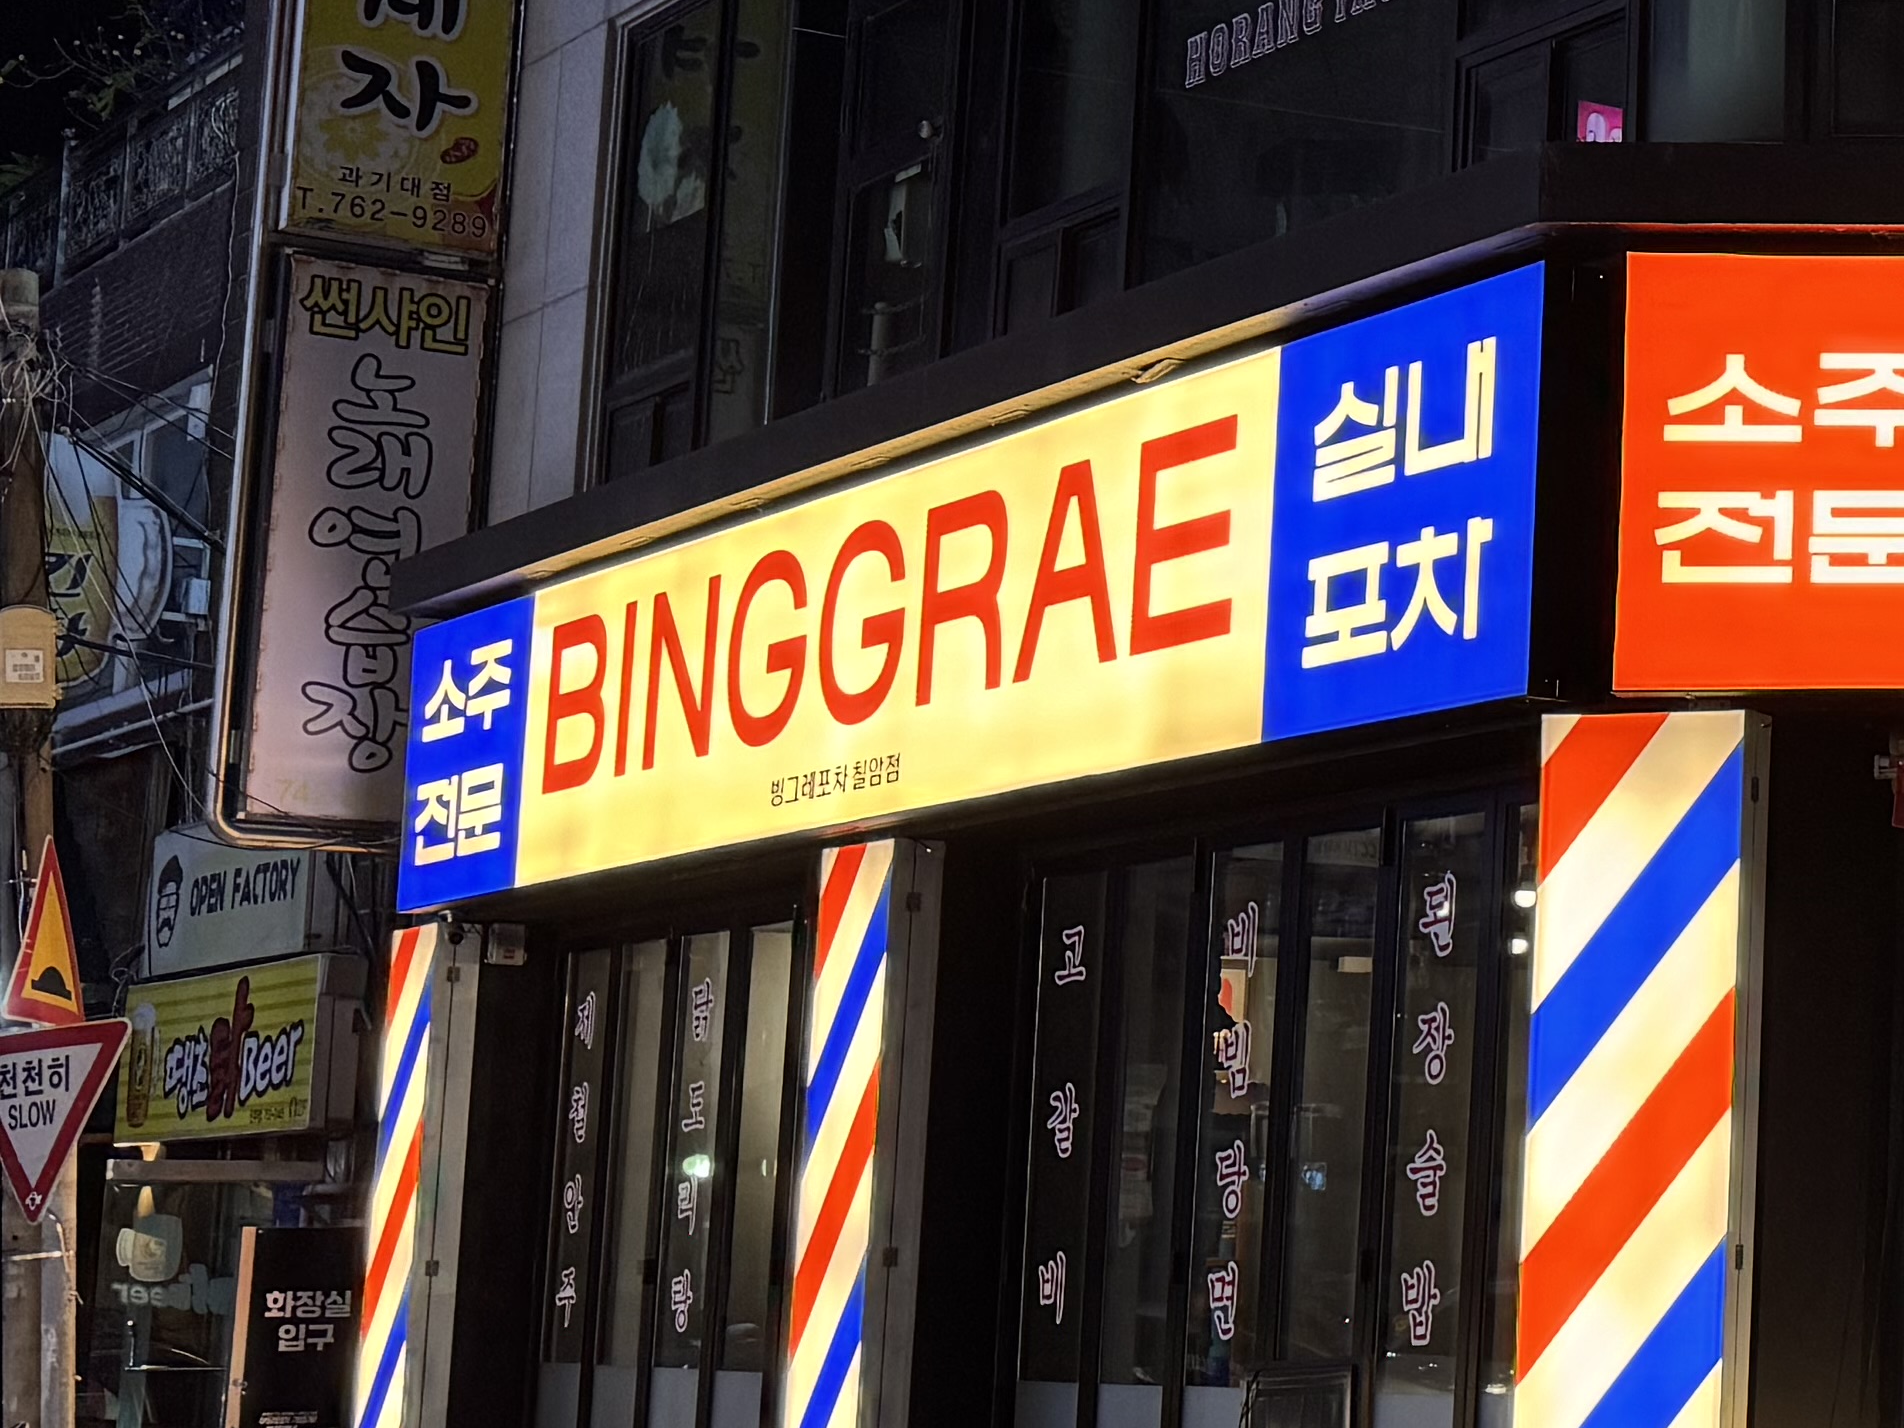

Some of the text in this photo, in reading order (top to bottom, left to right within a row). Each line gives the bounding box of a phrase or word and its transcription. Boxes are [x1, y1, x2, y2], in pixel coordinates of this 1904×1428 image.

[295, 183, 489, 241] T.762-9289
[299, 274, 470, 355] 썬샤인
[1309, 335, 1498, 506] 실내
[539, 413, 1239, 796] BINGGRAE
[1300, 514, 1494, 673] 포차
[418, 638, 514, 747] 소주
[413, 761, 503, 866] 전문
[769, 764, 848, 809] 빙그레포차
[189, 856, 302, 918] OPEN FACTORY
[0, 1053, 71, 1102] 천천히
[8, 1098, 57, 1132] SLOW
[556, 990, 597, 1329] 제철안주
[1038, 924, 1087, 1326] 고갈비
[264, 1289, 352, 1320] 화장실
[277, 1323, 336, 1353] 입구
